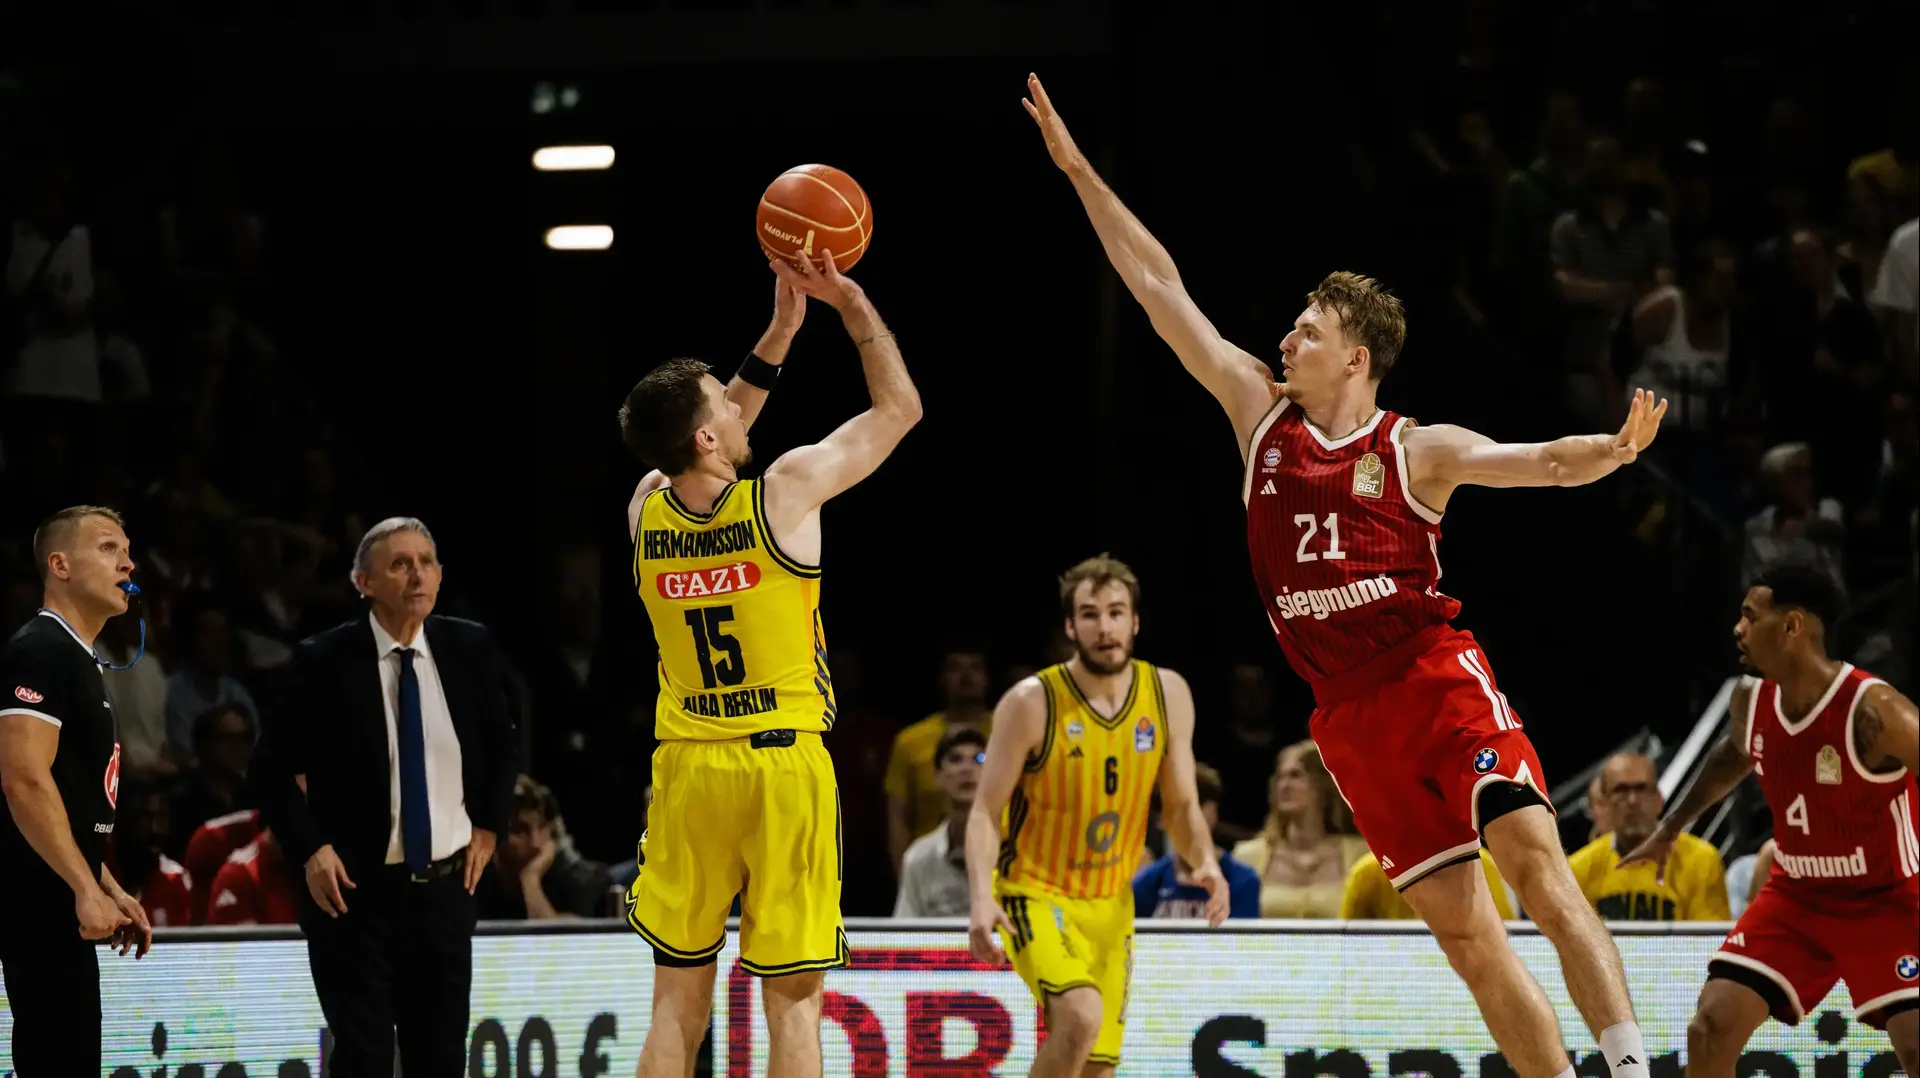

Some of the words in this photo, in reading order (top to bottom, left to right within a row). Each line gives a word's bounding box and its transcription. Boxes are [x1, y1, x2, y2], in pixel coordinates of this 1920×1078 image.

[1356, 482, 1378, 494] BBL
[644, 520, 756, 560] HERMANNSSON
[1294, 512, 1346, 563] 21
[1276, 573, 1398, 620] siegmund
[684, 605, 746, 689] 15
[723, 688, 777, 718] BERLIN
[1105, 756, 1118, 796] 6
[1786, 793, 1810, 835] 4
[1774, 845, 1867, 879] gmund
